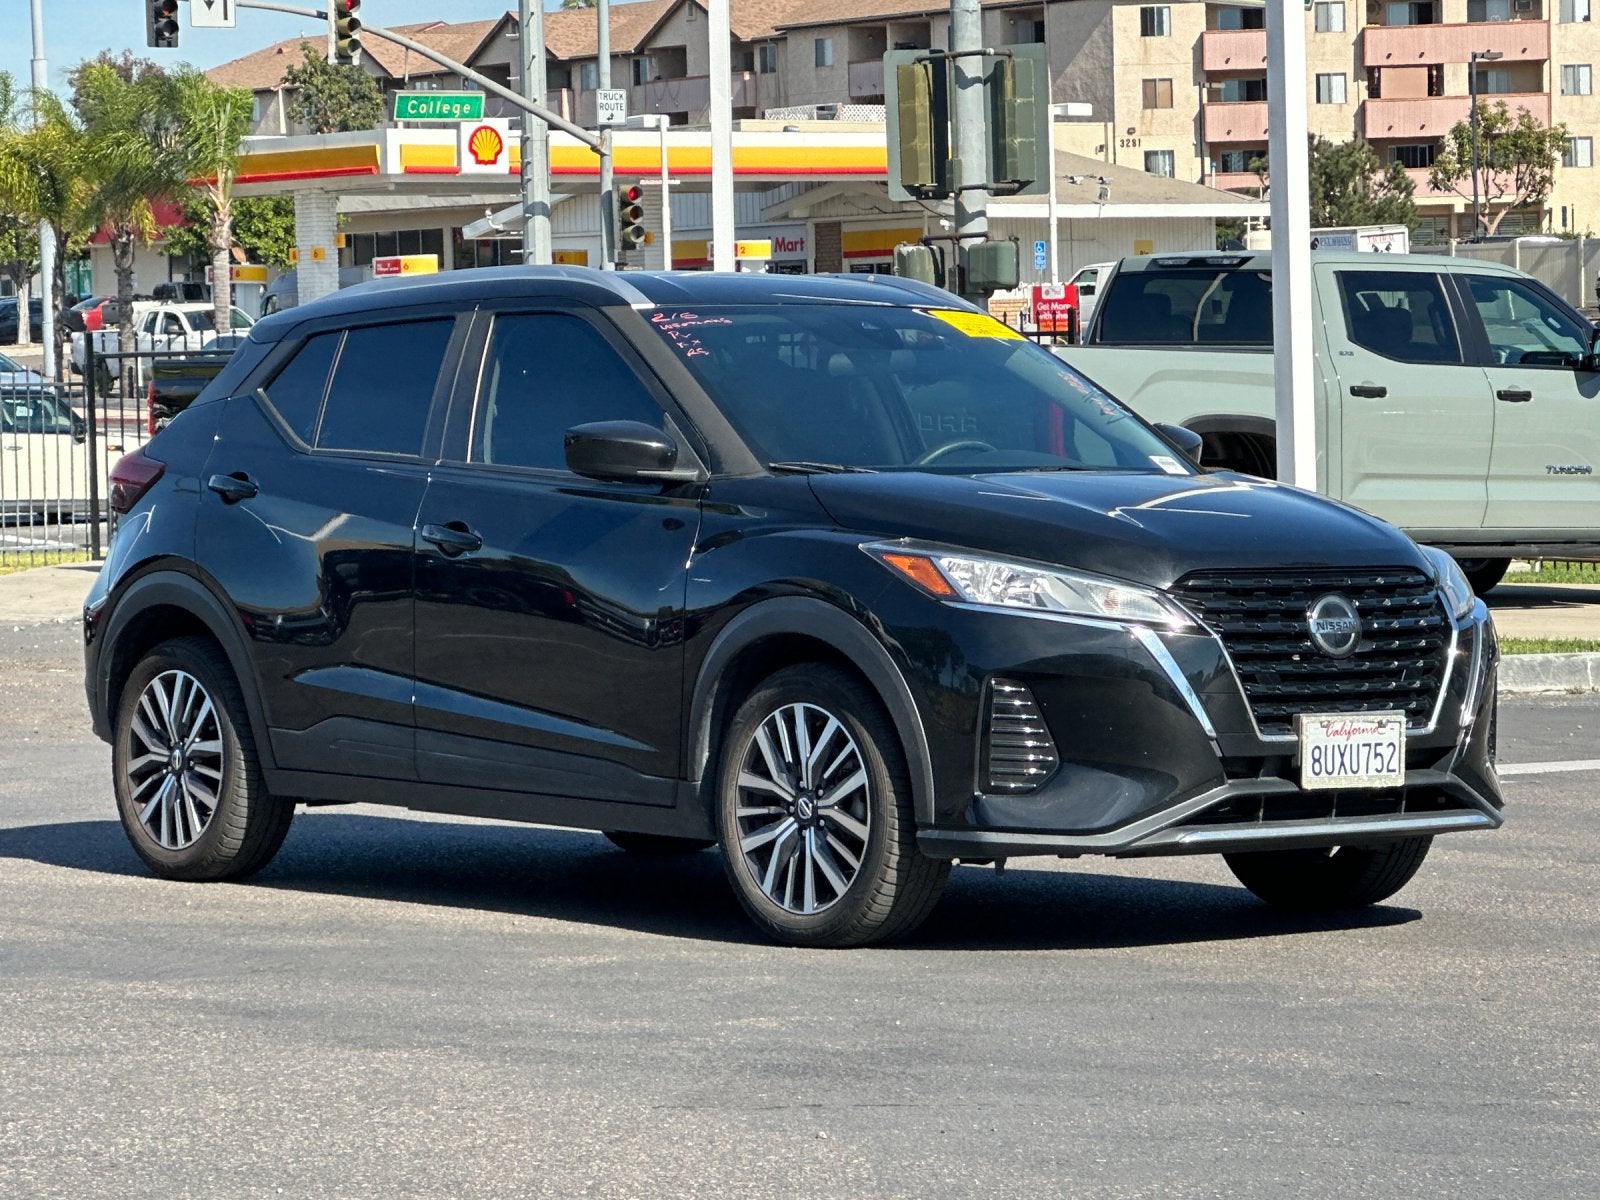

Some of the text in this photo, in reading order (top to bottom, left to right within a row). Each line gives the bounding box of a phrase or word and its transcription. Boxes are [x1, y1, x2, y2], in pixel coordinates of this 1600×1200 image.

[599, 92, 624, 101] TRUCK
[407, 100, 471, 118] College
[600, 102, 624, 111] ROUTE
[740, 246, 746, 254] 2
[774, 237, 805, 253] Mart
[403, 262, 410, 271] 6
[1037, 302, 1050, 310] Get
[1545, 463, 1593, 475] TUNDRA
[1316, 620, 1356, 632] NISSAN
[1326, 719, 1386, 741] California
[1311, 742, 1397, 776] 8UXU752
